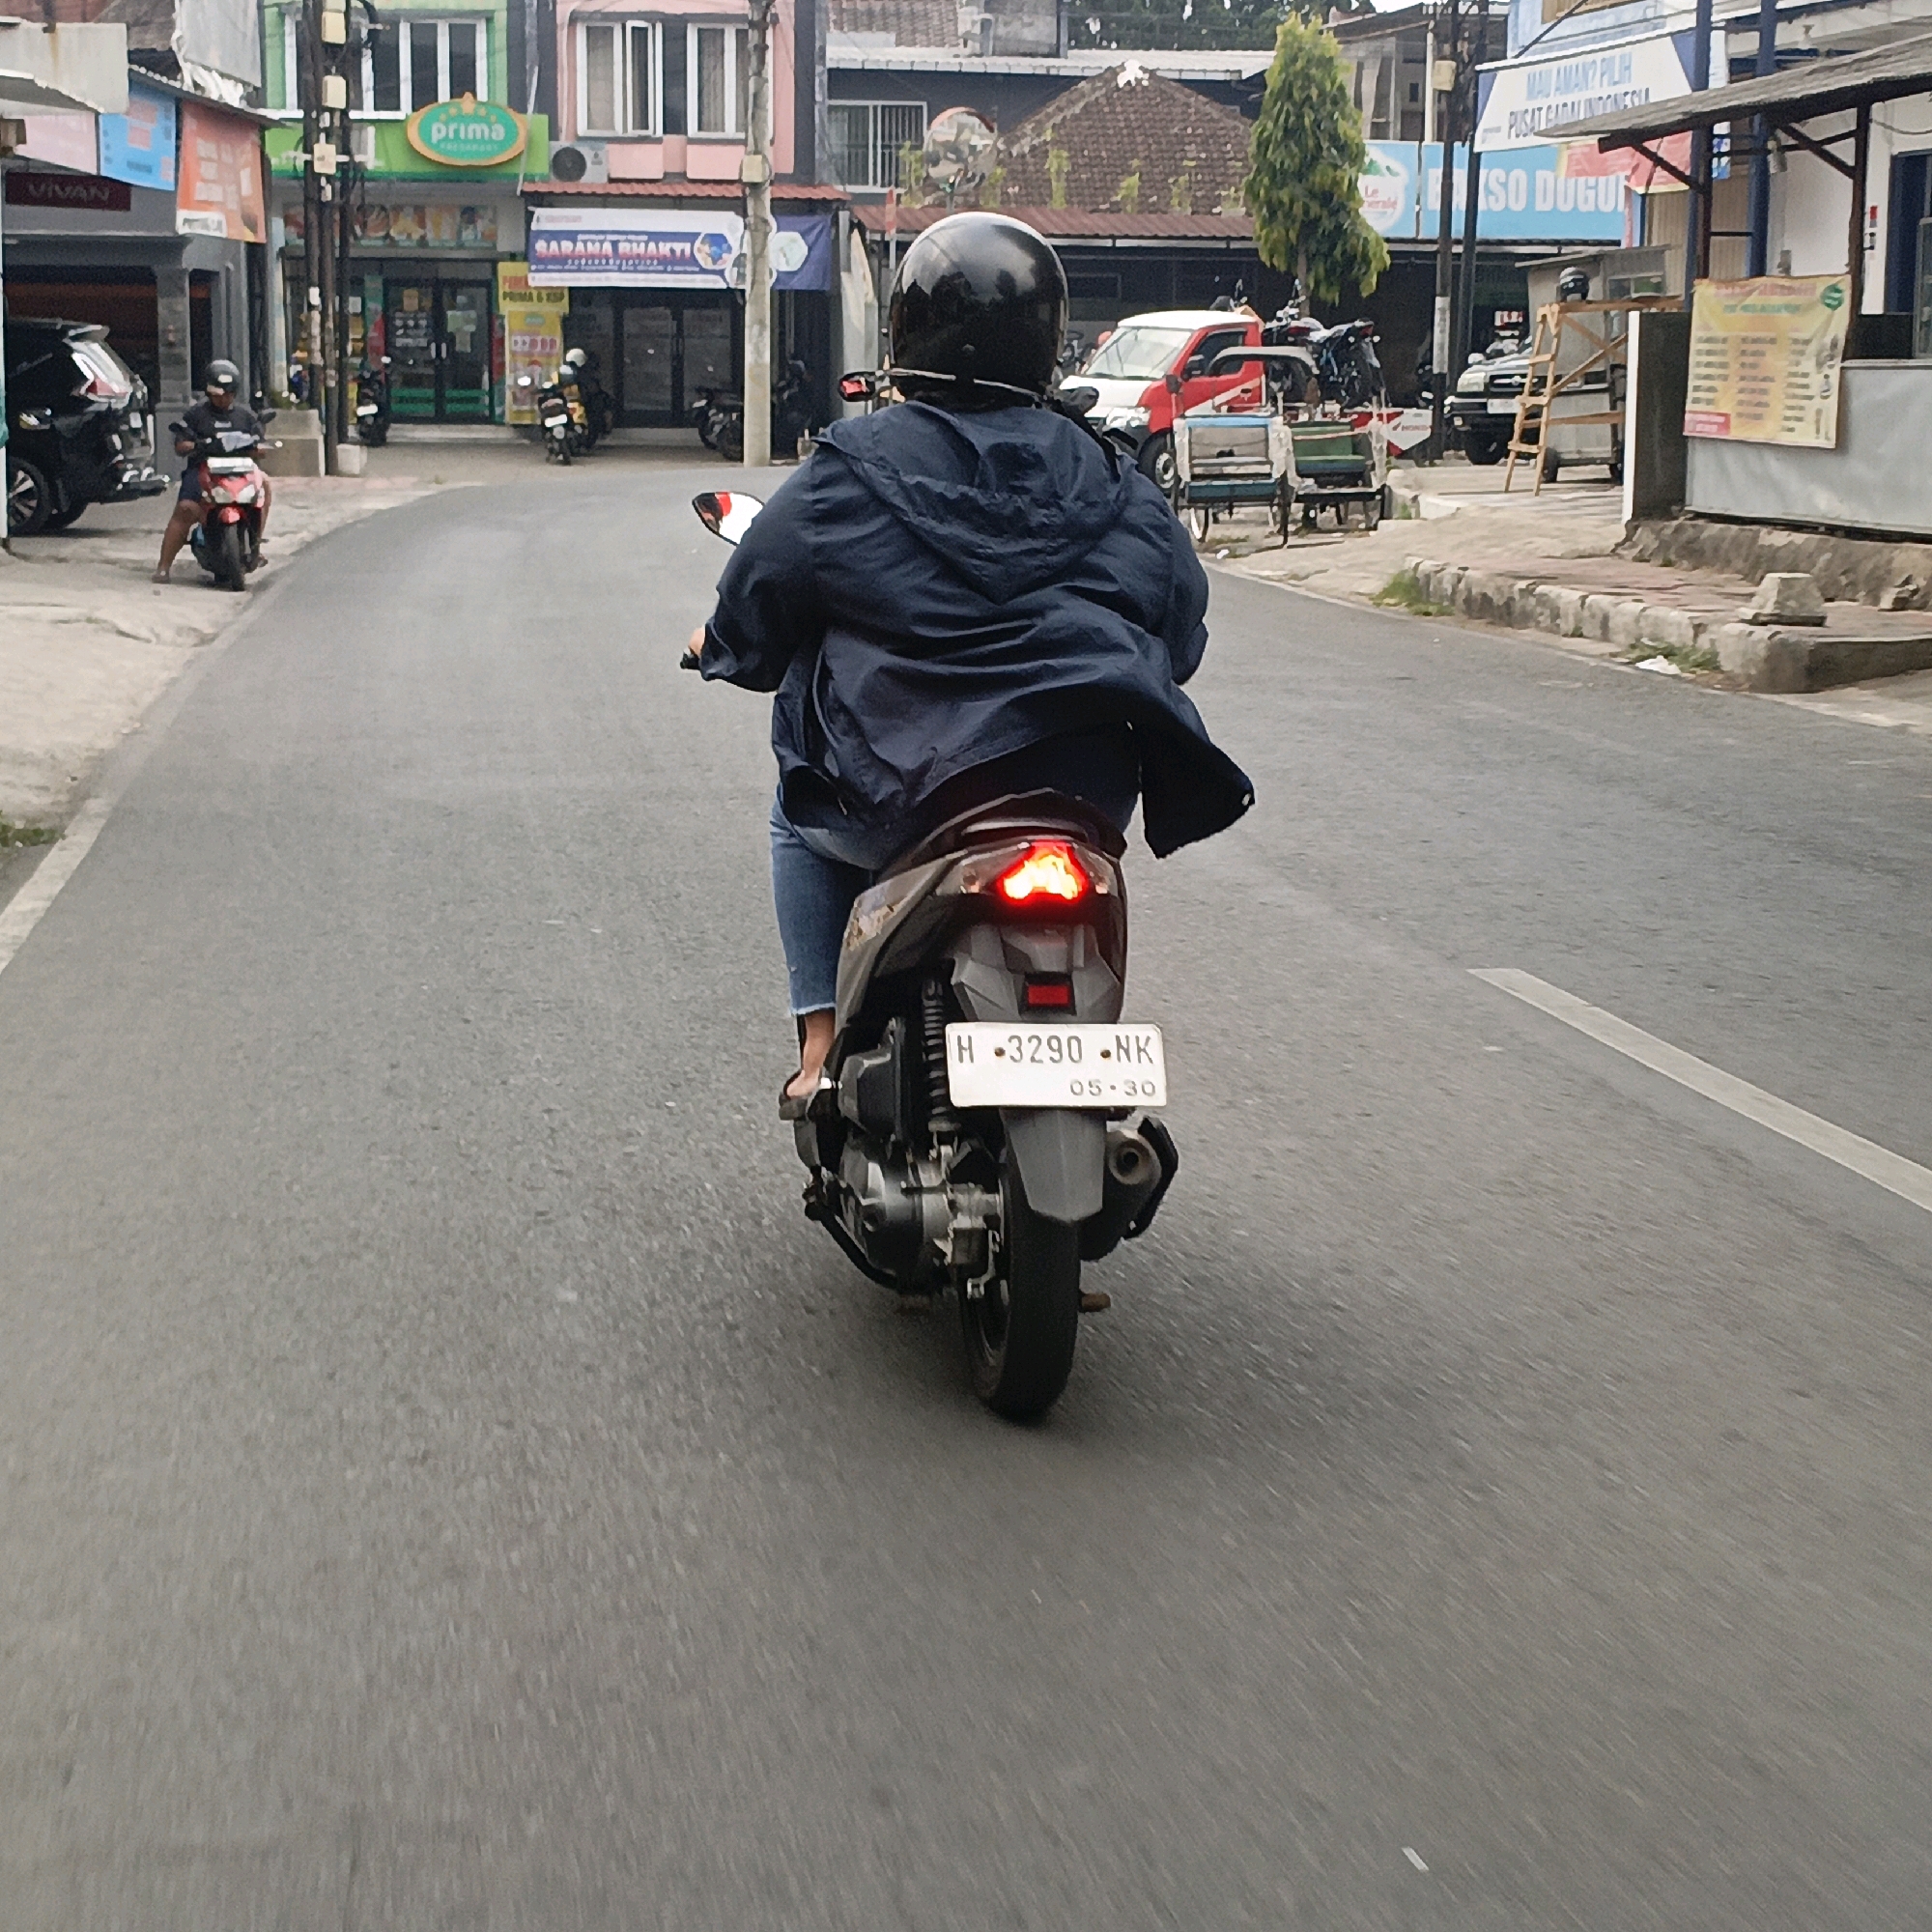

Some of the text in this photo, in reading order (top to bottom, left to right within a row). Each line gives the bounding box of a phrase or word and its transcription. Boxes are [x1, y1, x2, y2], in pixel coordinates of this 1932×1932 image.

[431, 121, 506, 144] prima
[1508, 107, 1544, 140] PUSAT
[1428, 167, 1528, 213] BAKSO
[534, 239, 692, 261] SARANA BHAKTI
[956, 1034, 1154, 1065] H 3290 NK
